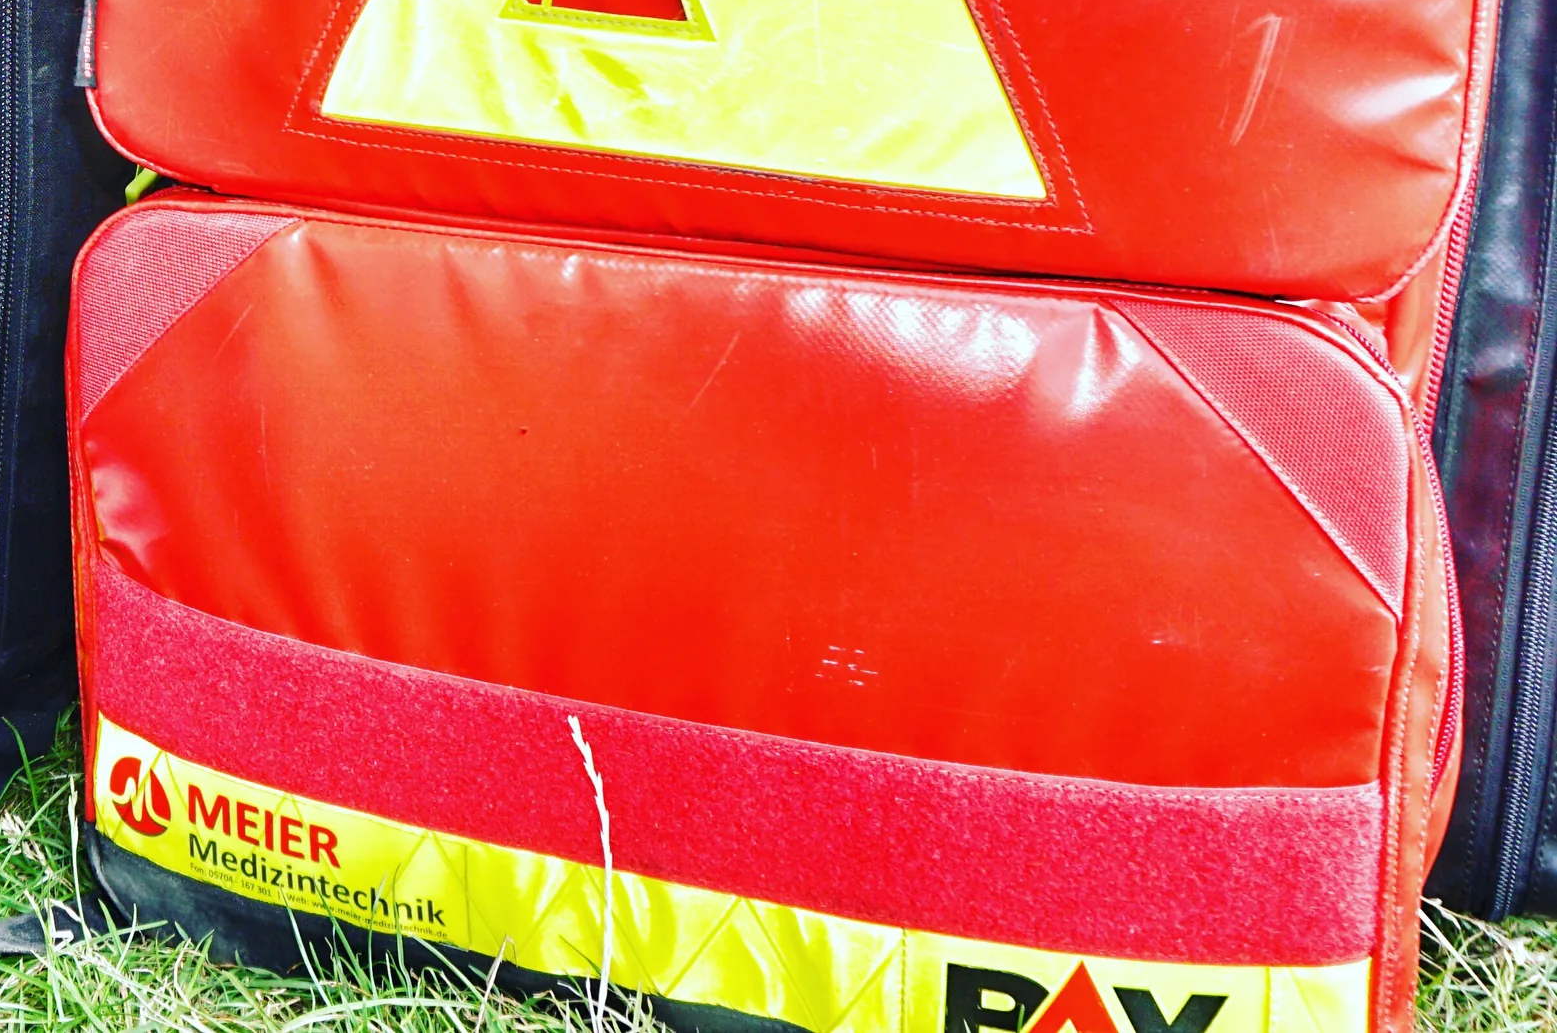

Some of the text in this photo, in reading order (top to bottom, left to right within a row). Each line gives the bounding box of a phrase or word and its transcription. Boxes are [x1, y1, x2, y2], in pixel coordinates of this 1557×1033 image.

[188, 783, 342, 870] MEIER
[188, 833, 447, 928] Medizintechnik
[190, 862, 207, 876] Fon:
[208, 869, 234, 884] 05704
[241, 879, 255, 891] 167
[256, 885, 272, 897] 301
